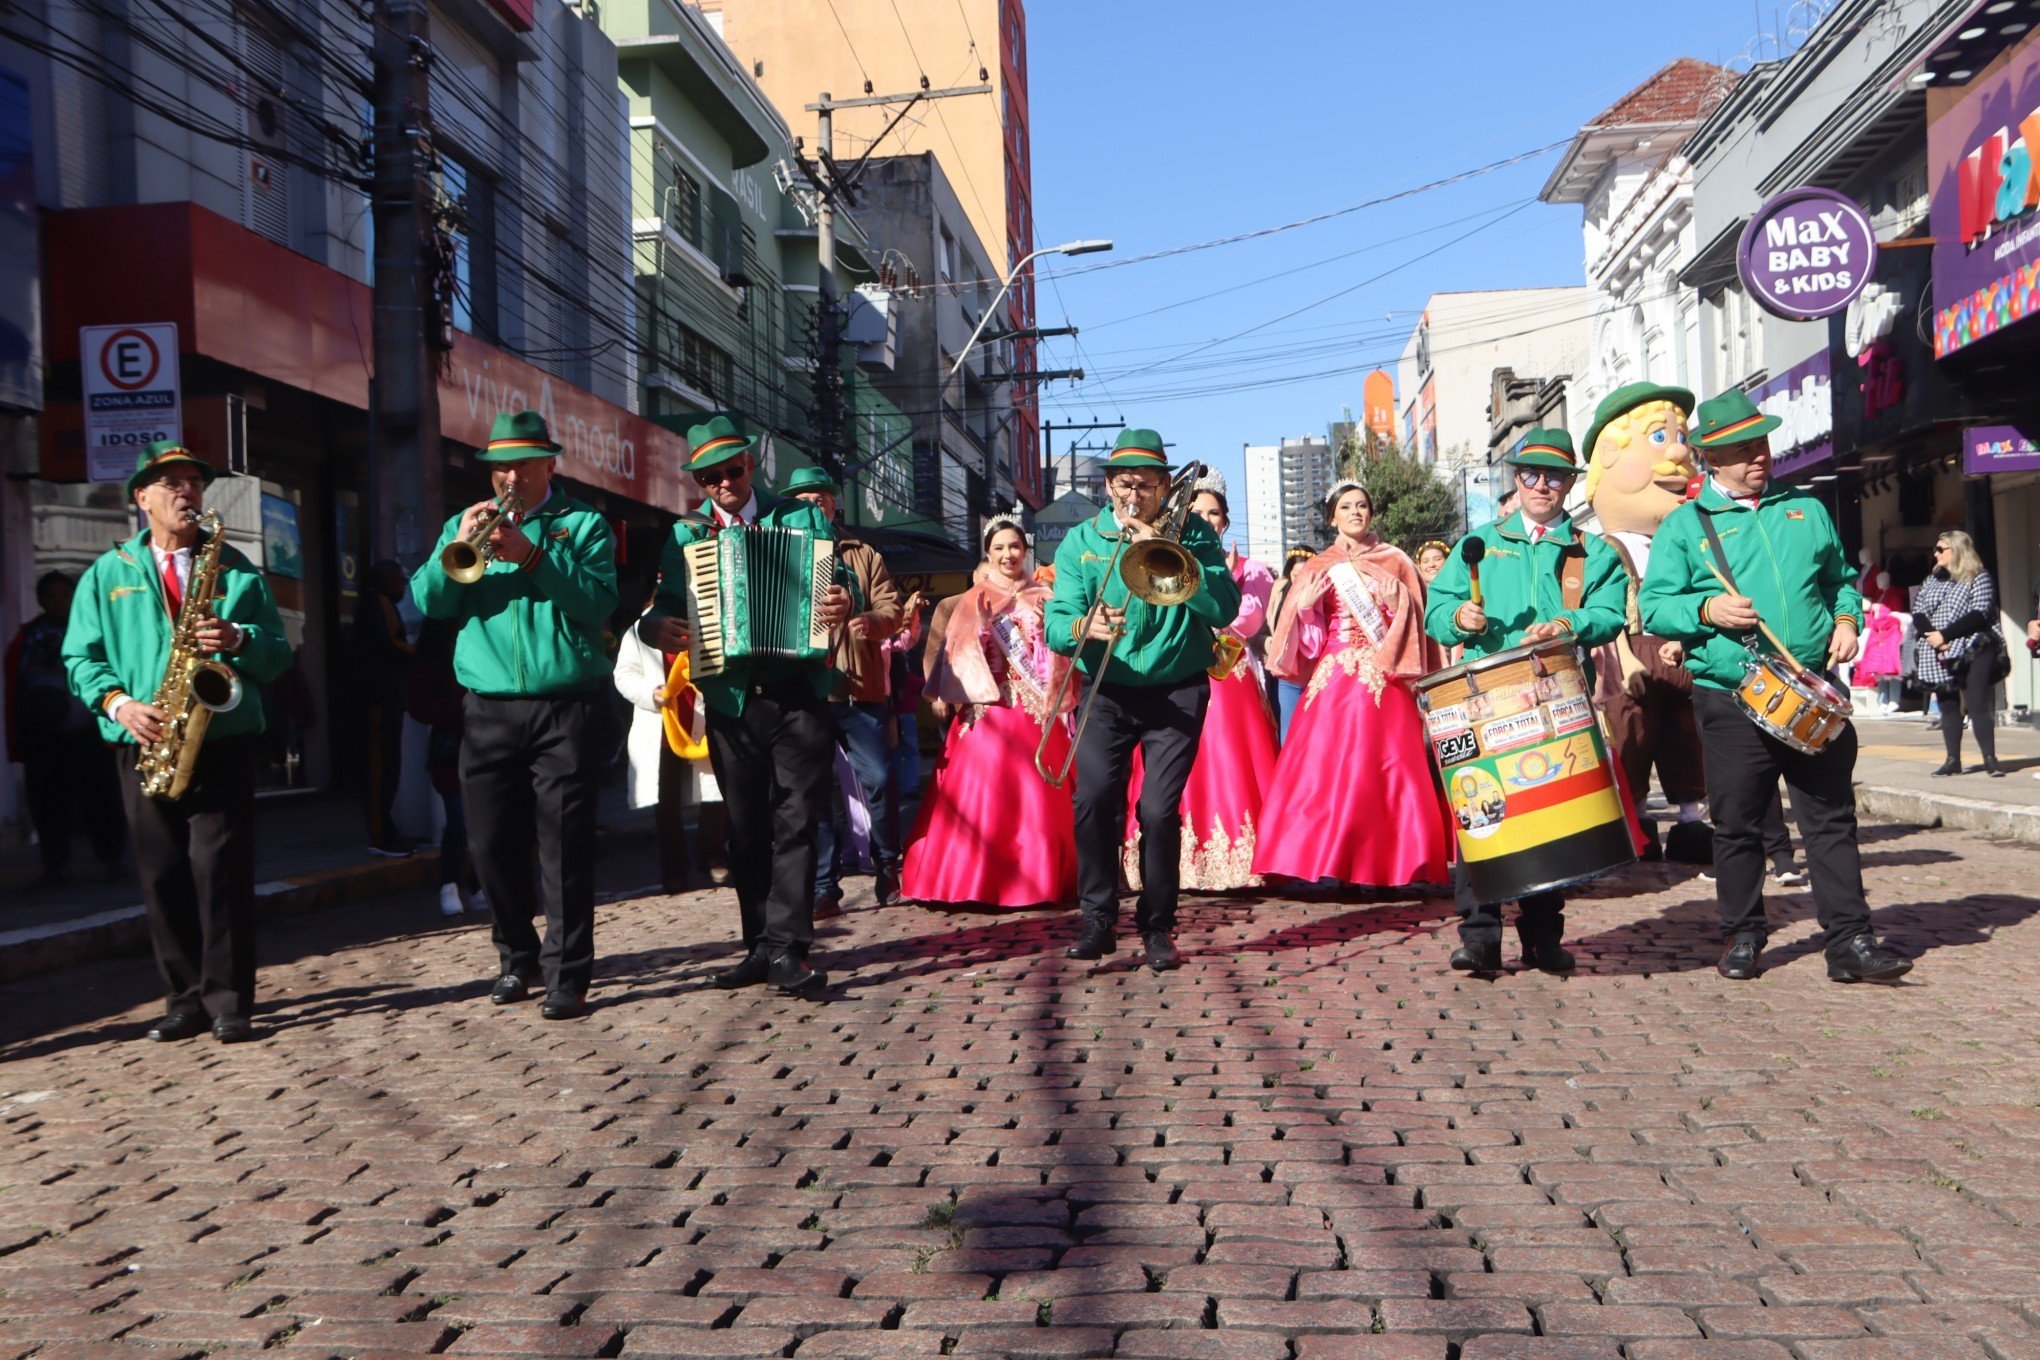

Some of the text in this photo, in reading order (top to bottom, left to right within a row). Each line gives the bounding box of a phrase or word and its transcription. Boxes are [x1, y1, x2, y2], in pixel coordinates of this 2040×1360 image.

[732, 169, 766, 221] RASIL
[1768, 242, 1850, 272] BABY
[1774, 271, 1852, 295] & KIDS
[117, 342, 142, 378] E
[92, 394, 170, 408] ZONA AZUL
[101, 432, 167, 446] IDOSO
[566, 414, 635, 481] moda
[1516, 716, 1540, 731] TOTAL
